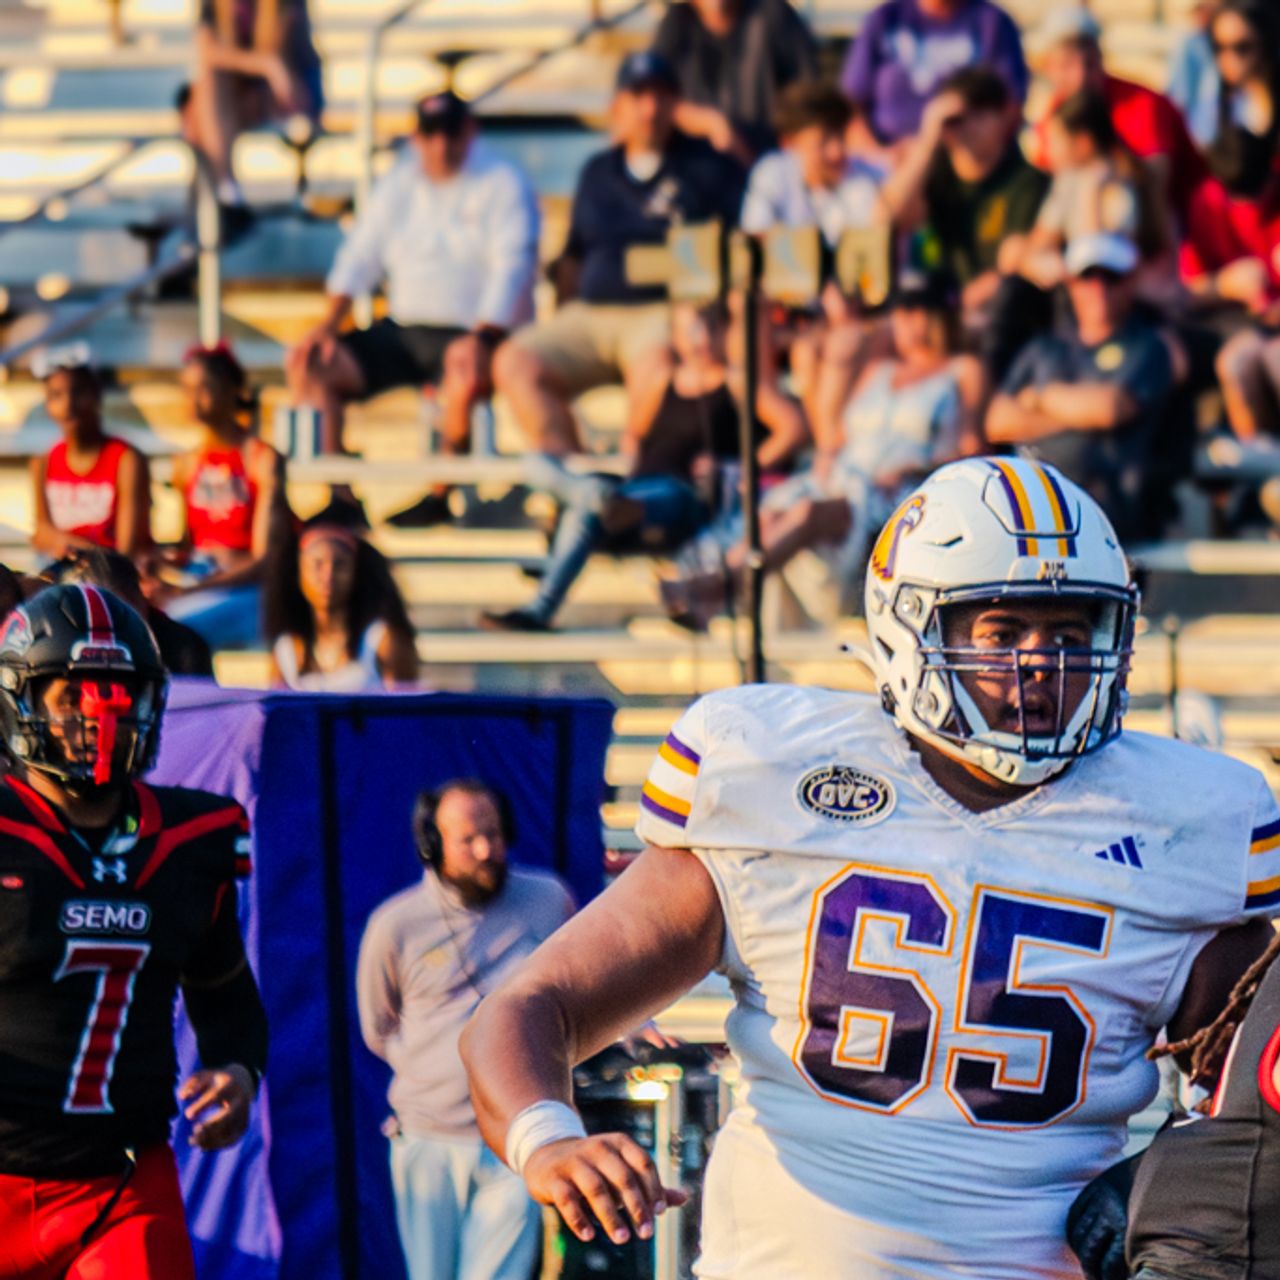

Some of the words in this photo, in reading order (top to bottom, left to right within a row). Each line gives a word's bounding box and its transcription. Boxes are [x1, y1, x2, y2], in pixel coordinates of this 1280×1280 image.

[63, 903, 149, 931] SEMO
[792, 861, 1115, 1131] 65
[53, 939, 151, 1114] 7
